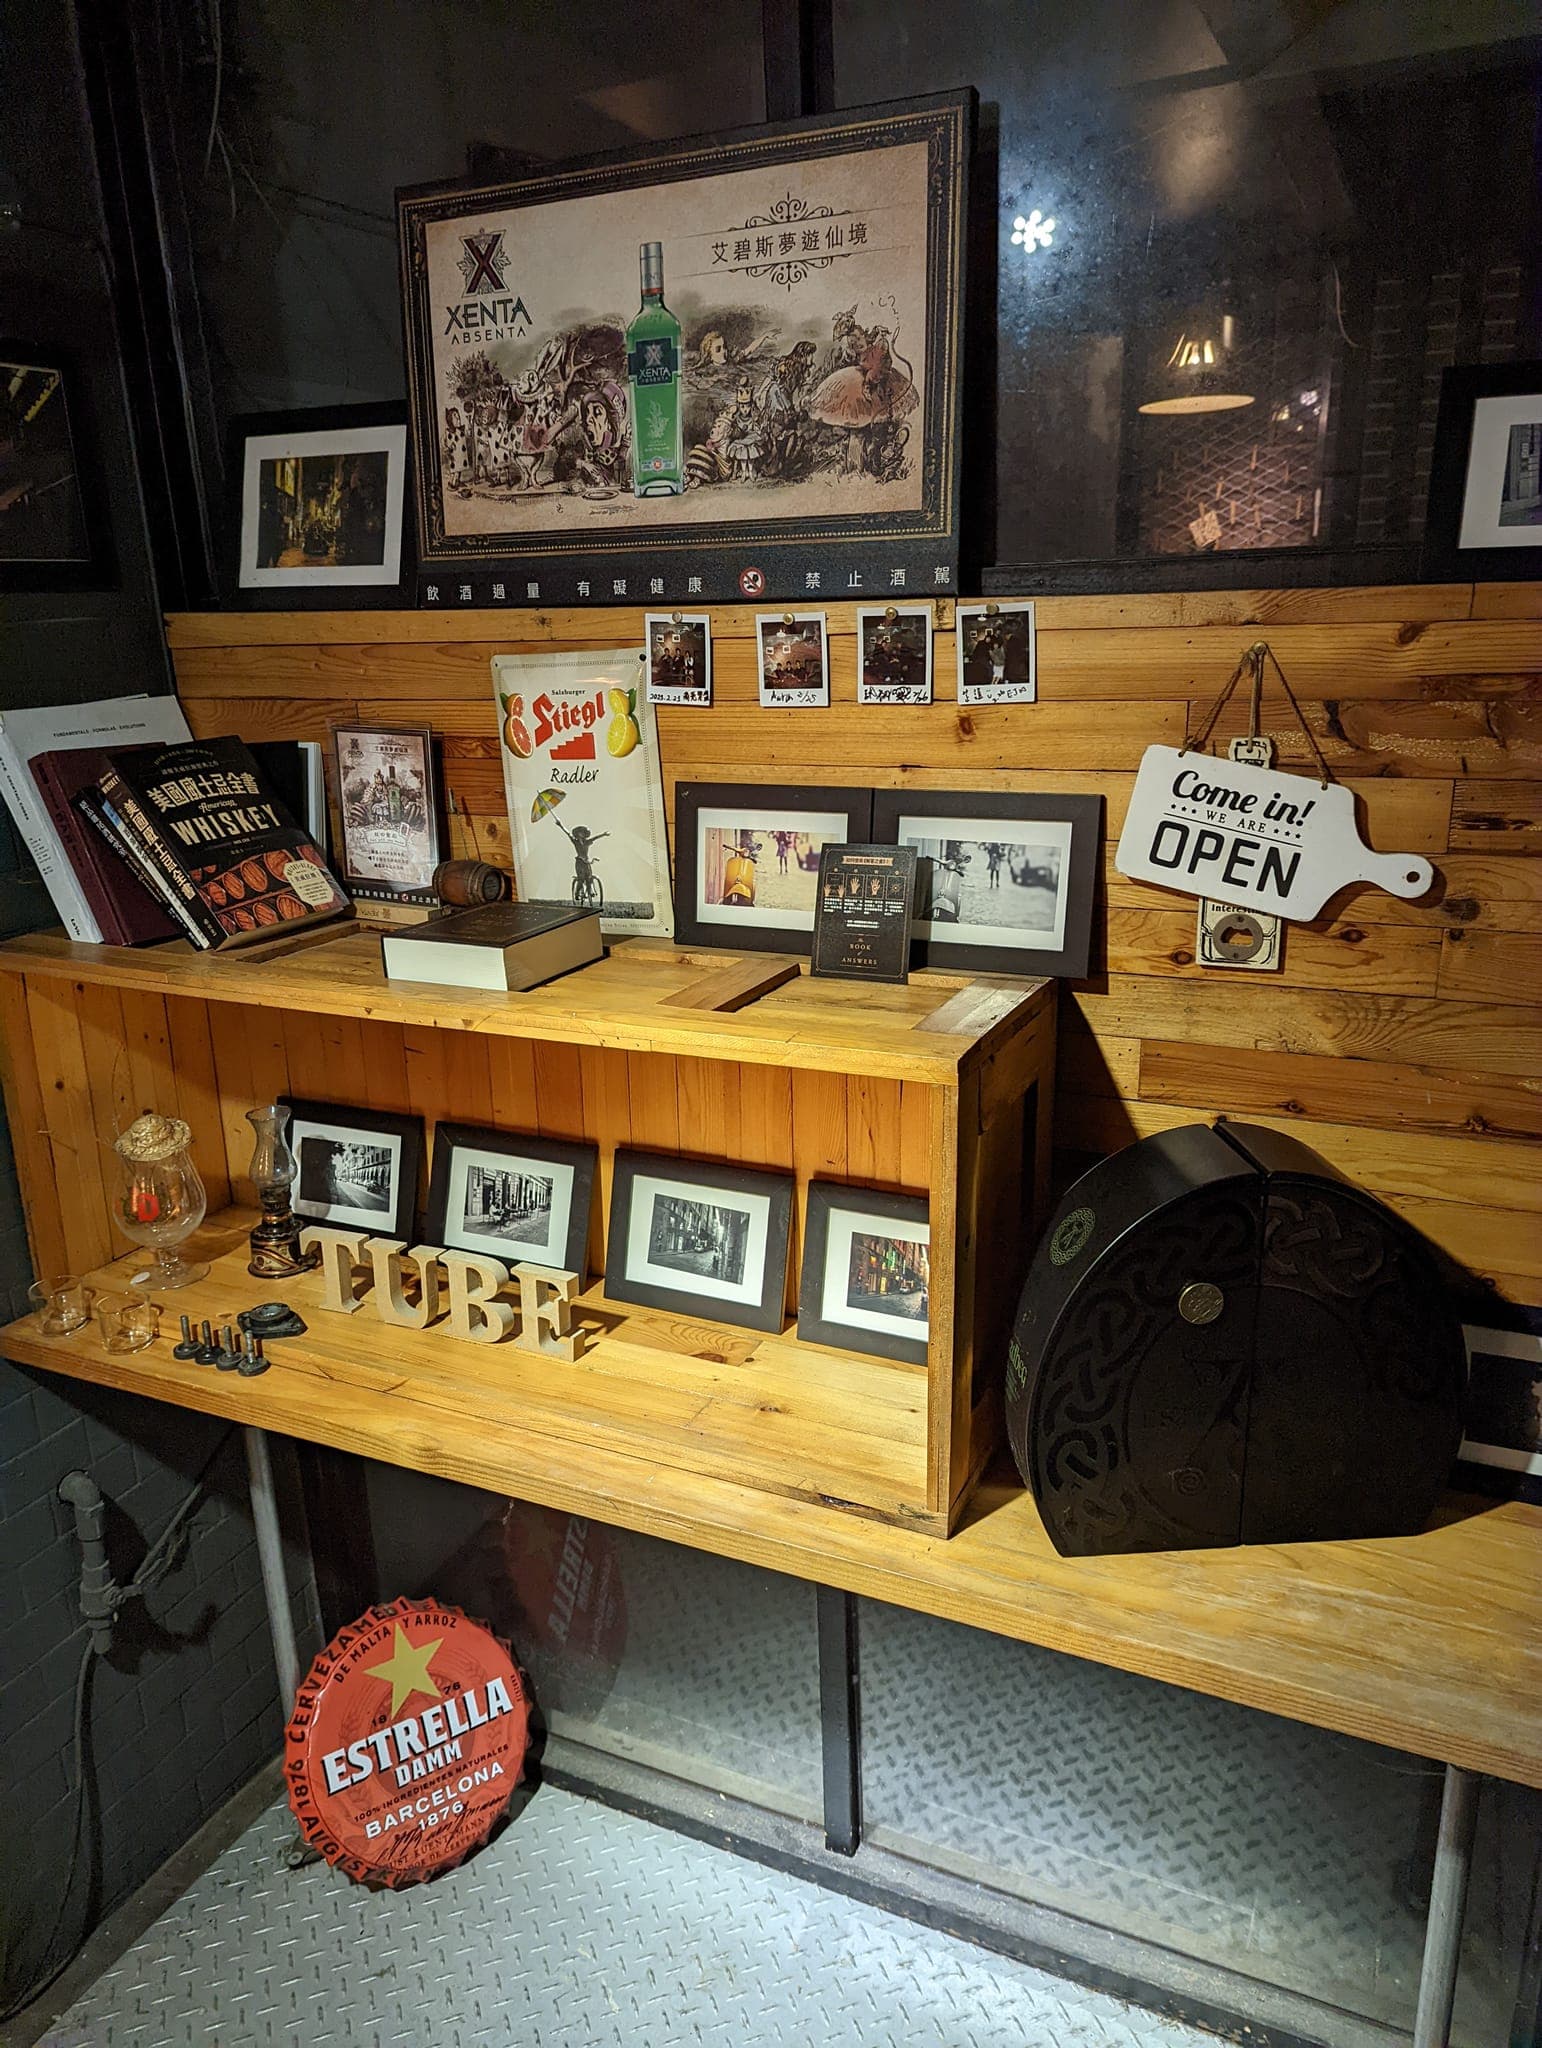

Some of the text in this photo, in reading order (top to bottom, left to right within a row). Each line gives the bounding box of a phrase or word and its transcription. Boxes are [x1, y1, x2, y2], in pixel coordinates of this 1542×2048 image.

[711, 221, 869, 265] 艾碧斯夢遊仙境
[444, 297, 533, 336] XENTA
[451, 326, 526, 345] ABSENTA
[426, 566, 950, 601] 飲酒過量 有礙健康 禁止酒駕
[532, 690, 606, 748] Stiegl
[146, 772, 261, 813] 美國威士忌全書
[550, 765, 599, 784] Radler
[1172, 770, 1316, 827] Come in!
[1206, 810, 1267, 833] WE ARE
[169, 803, 281, 846] WHISKEY
[1149, 820, 1301, 899] OPEN
[841, 957, 878, 966] ANSWERS
[849, 943, 871, 951] BOOK
[299, 1225, 585, 1362] TUBE
[333, 1663, 351, 1684] DE
[350, 1625, 391, 1663] MALTA
[402, 1616, 410, 1629] Y
[415, 1614, 457, 1629] ARROZ
[288, 1634, 354, 1744] CERVEZA
[372, 1681, 462, 1727] 18 76
[321, 1676, 515, 1798] ESTRELLA
[288, 1759, 310, 1809] 1876
[353, 1743, 510, 1823] 100% INGREDIENTES NATURALES
[395, 1738, 464, 1790] DAMM
[365, 1761, 505, 1840] BARCELONA
[418, 1800, 466, 1831] 1876
